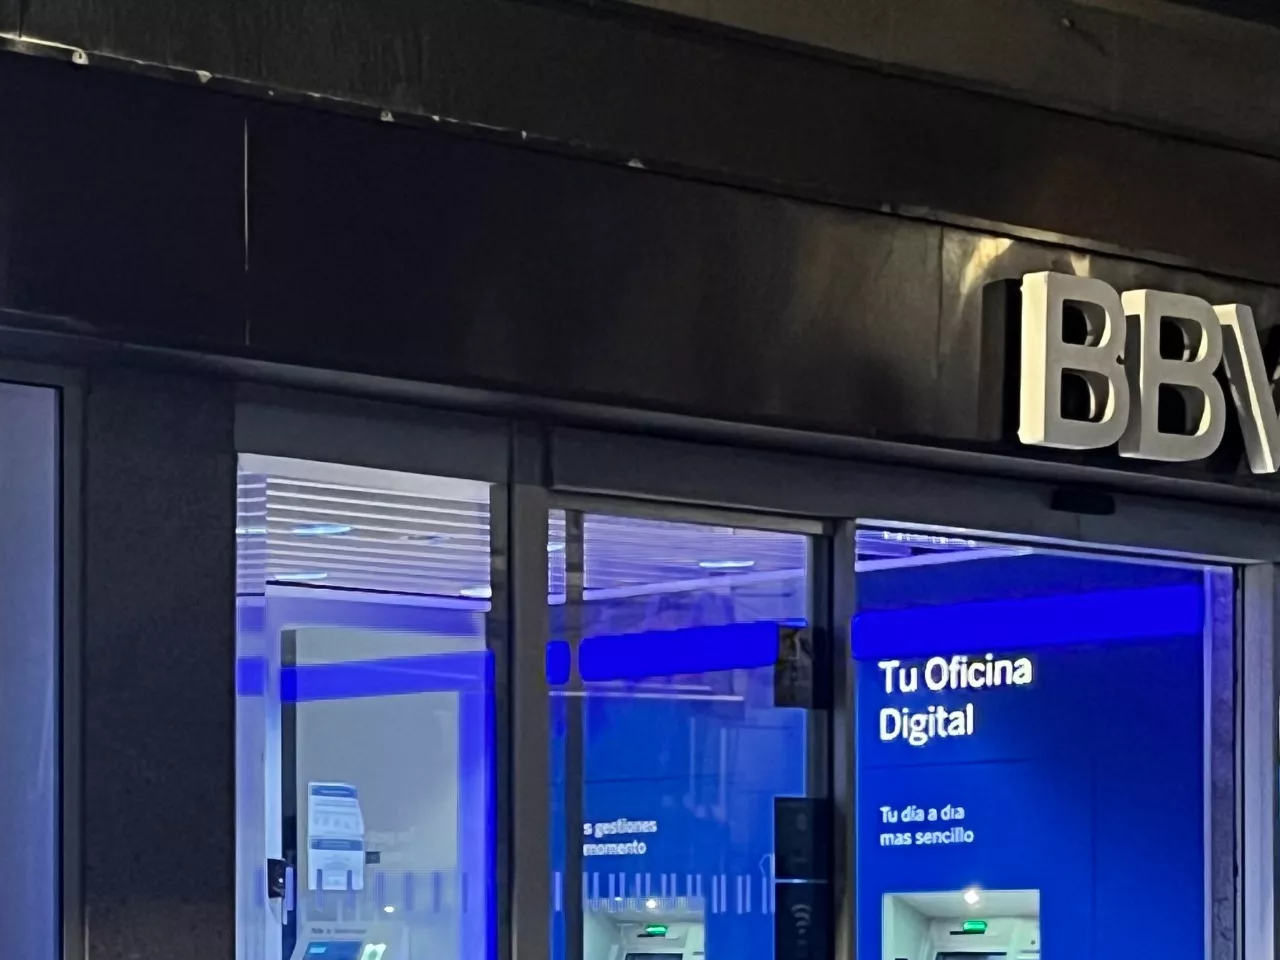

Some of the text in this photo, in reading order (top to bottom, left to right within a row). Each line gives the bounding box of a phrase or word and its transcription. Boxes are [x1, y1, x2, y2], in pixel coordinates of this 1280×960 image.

[878, 653, 1033, 694] Tu Oficina
[879, 703, 974, 746] Digital
[879, 806, 898, 823] Tu
[927, 808, 938, 821] a
[594, 818, 658, 838] gestiones
[915, 827, 975, 845] sencillo
[583, 839, 647, 856] momento
